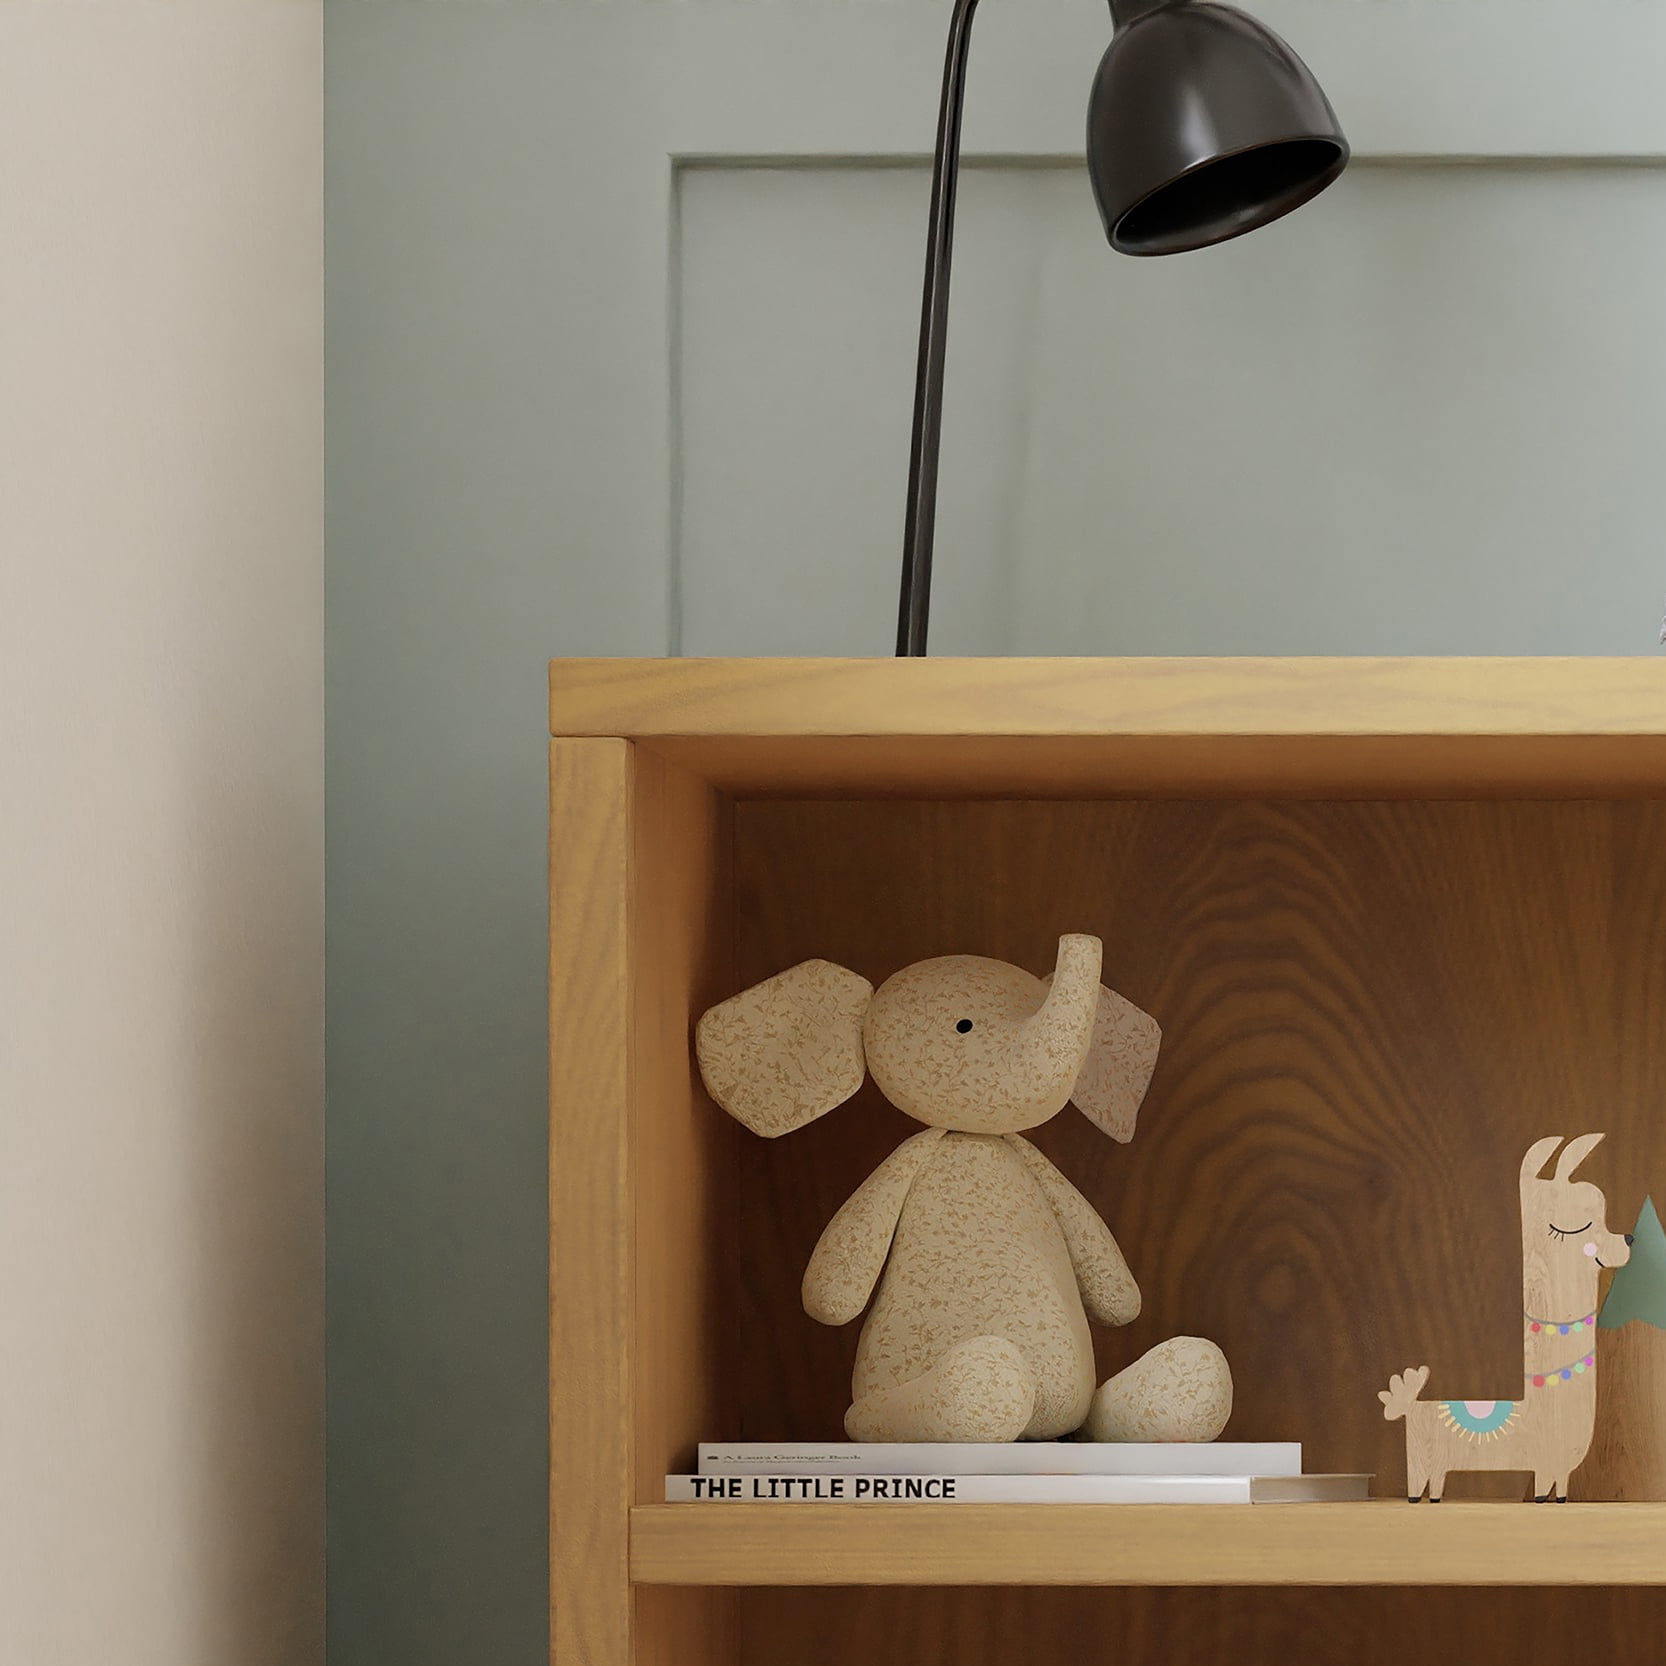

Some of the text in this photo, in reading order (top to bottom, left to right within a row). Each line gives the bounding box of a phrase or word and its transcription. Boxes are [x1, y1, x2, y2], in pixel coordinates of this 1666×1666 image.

[689, 1478, 957, 1499] THE LITTLE PRINCE
